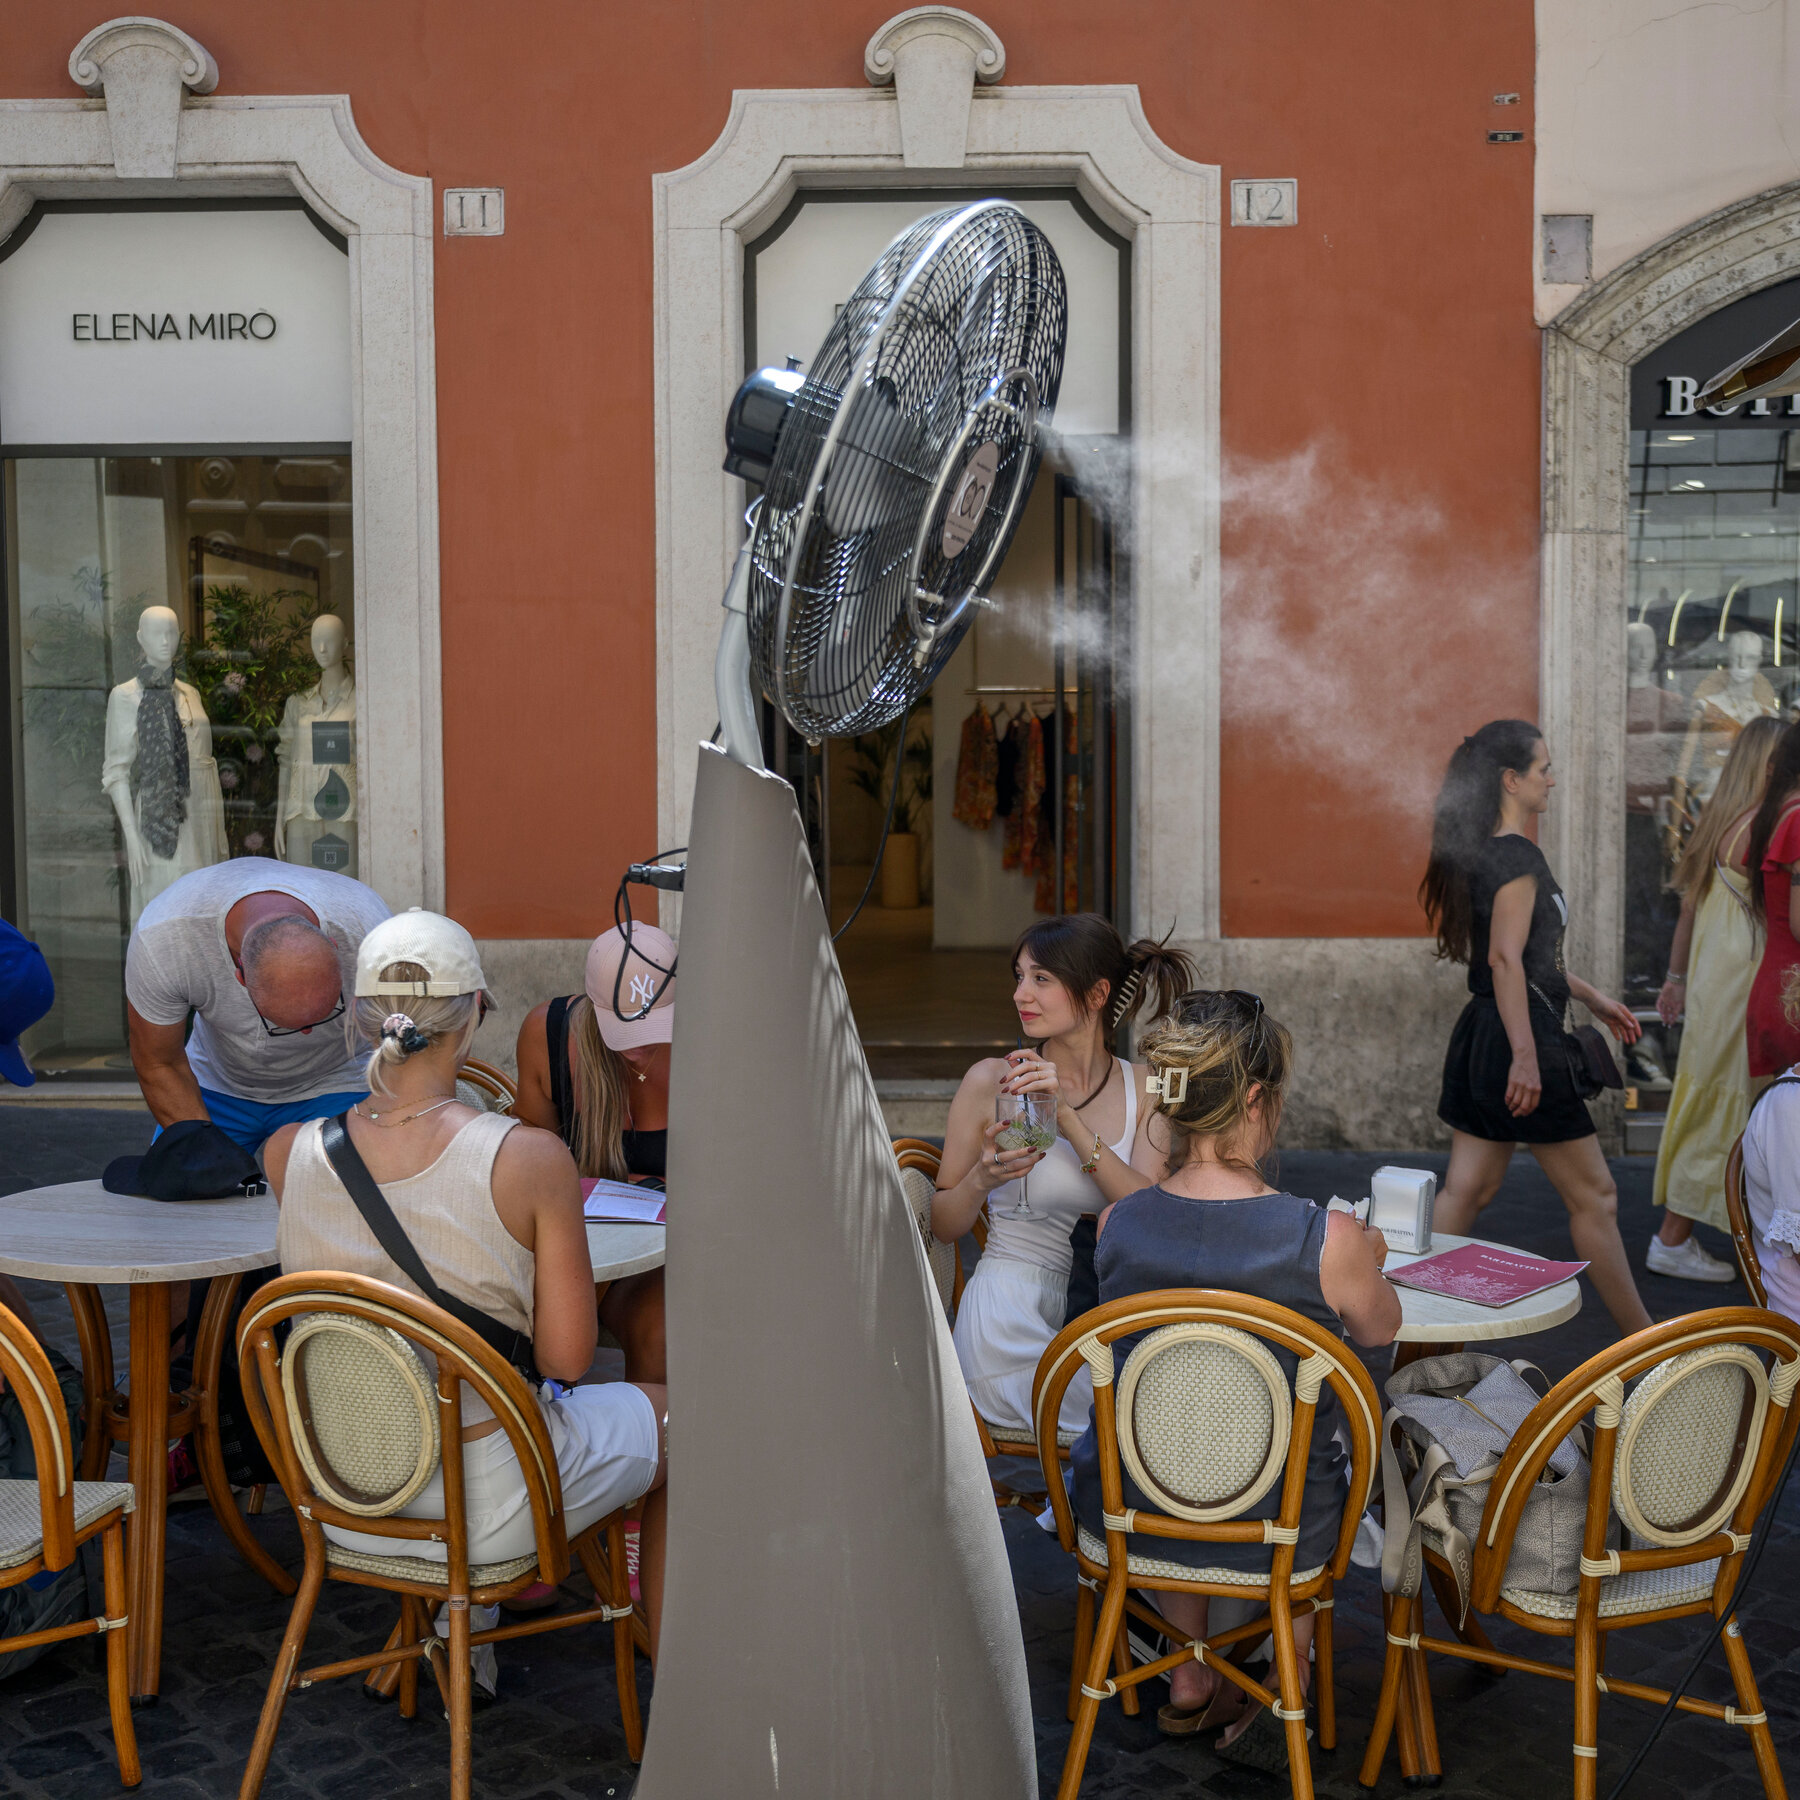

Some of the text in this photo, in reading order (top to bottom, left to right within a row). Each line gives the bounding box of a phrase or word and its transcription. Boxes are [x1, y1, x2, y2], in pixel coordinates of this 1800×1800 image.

[457, 194, 488, 230] 11
[1244, 187, 1284, 221] 12
[72, 312, 182, 342] ELENA
[629, 973, 655, 1007] NY
